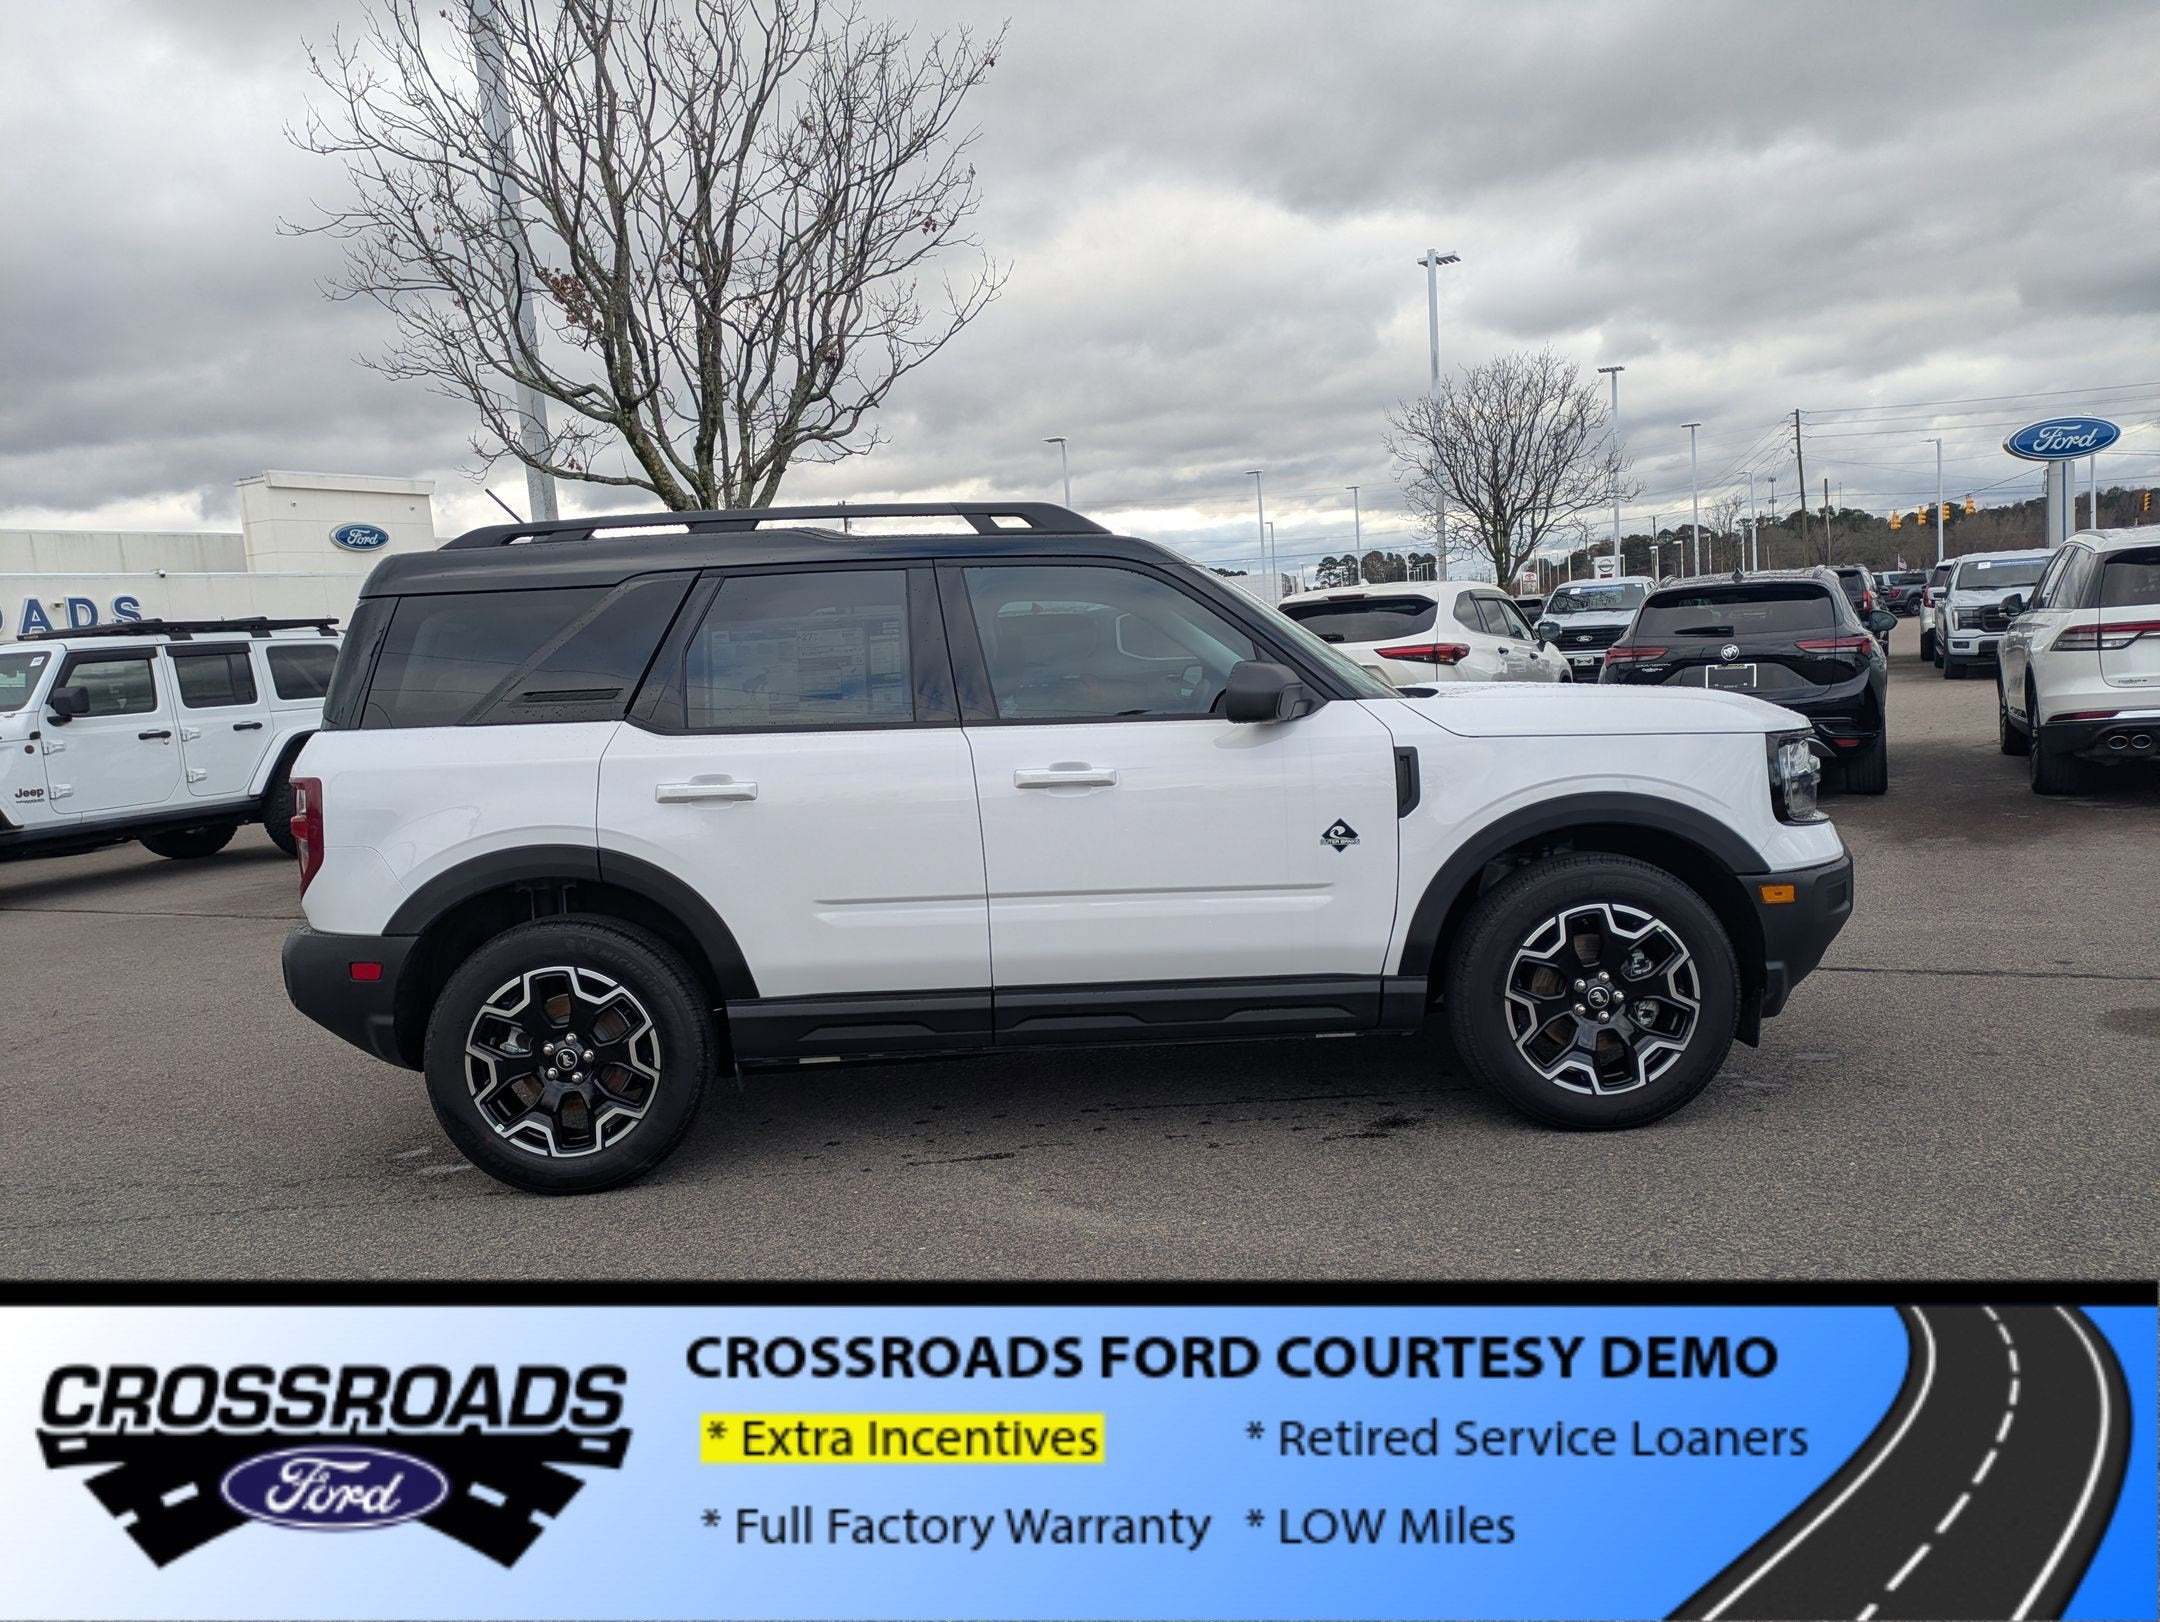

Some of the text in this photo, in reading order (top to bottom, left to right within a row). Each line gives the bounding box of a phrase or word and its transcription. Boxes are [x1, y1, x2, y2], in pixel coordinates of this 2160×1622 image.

[2032, 425, 2099, 452] Ford
[347, 529, 379, 545] Ford
[0, 596, 141, 635] ADS
[14, 788, 44, 798] Jeep
